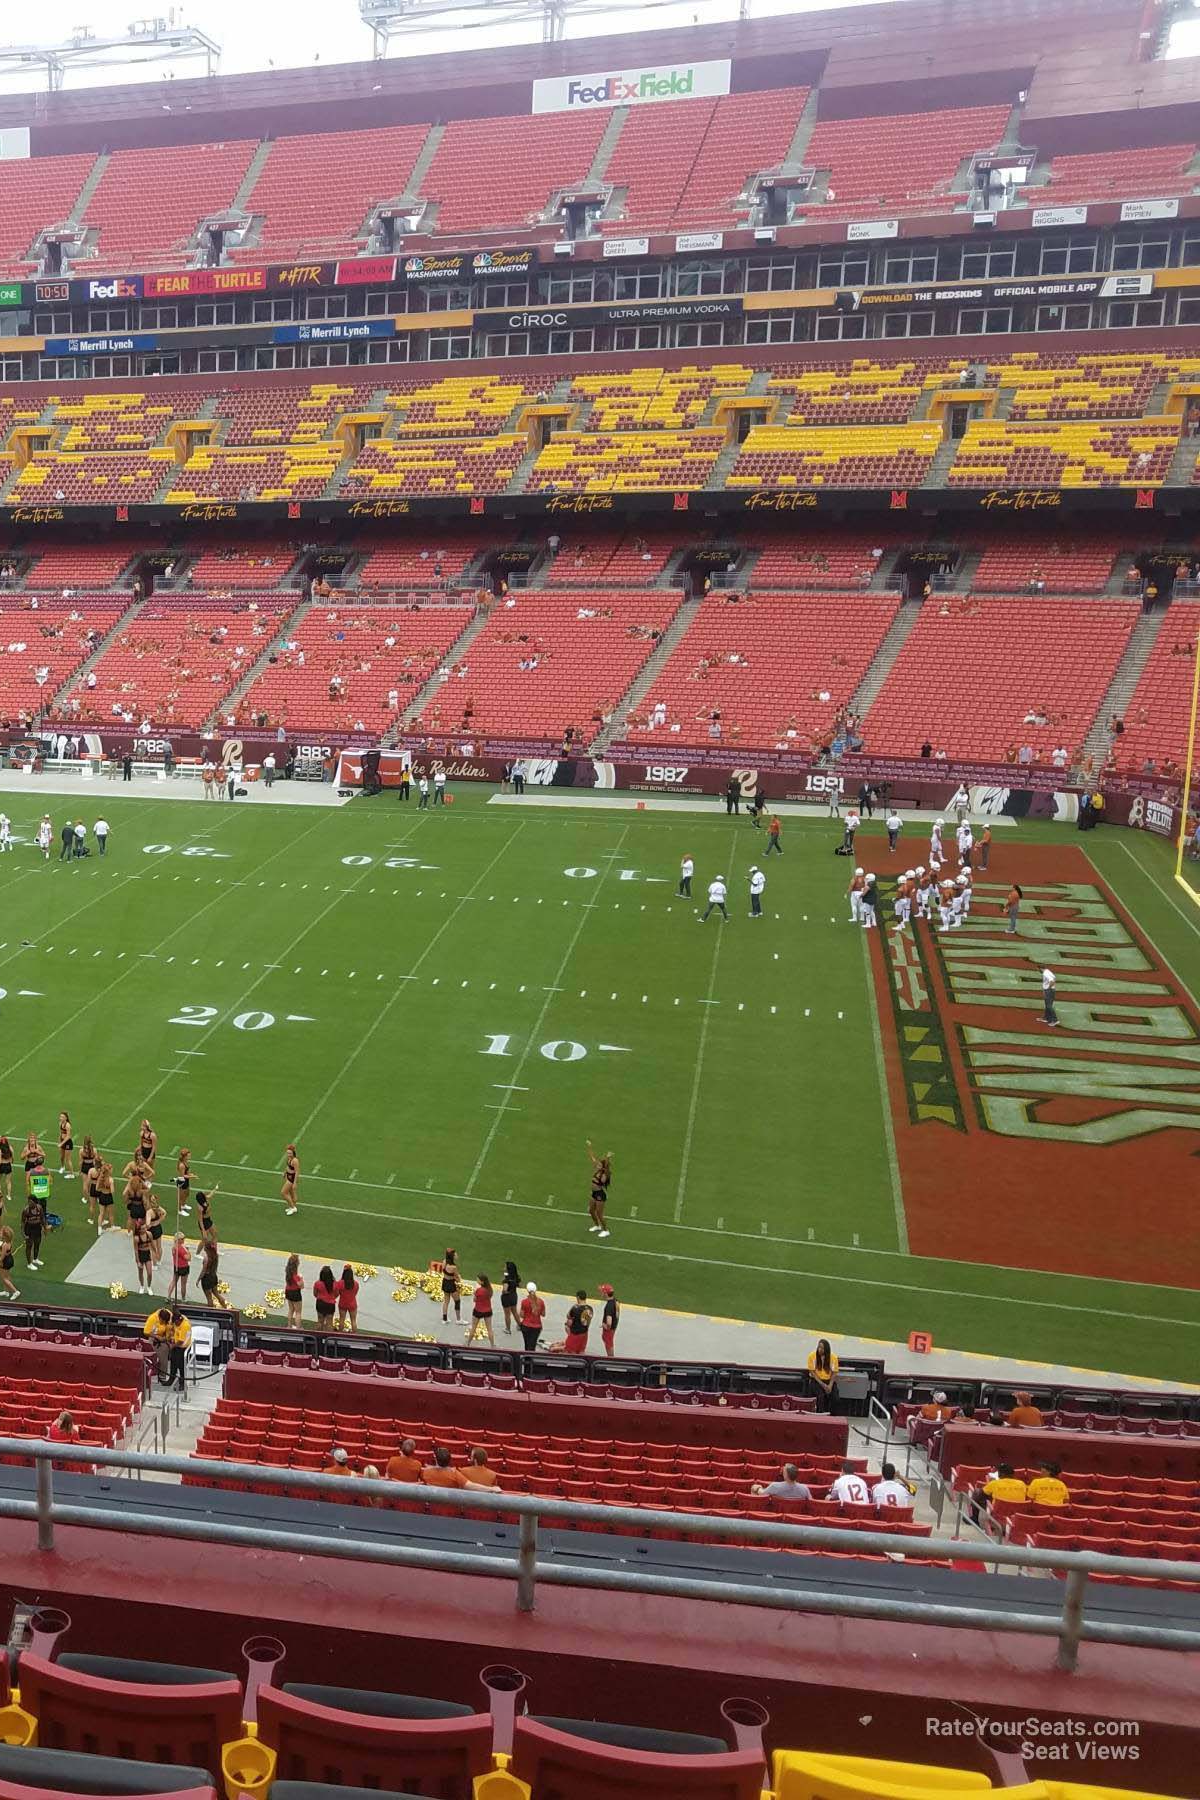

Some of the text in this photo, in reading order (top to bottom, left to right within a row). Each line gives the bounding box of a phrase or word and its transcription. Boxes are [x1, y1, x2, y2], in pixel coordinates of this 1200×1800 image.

[568, 70, 693, 104] FedExField
[422, 256, 464, 271] Sports
[491, 251, 533, 266] Sports
[406, 269, 460, 279] WASHINGTON
[474, 264, 528, 274] WASHINGTON
[89, 279, 137, 299] FedEx
[862, 293, 913, 304] DOWNLOAD
[935, 289, 983, 299] REDSKINS
[994, 286, 1037, 297] OFFICIAL
[1038, 284, 1075, 294] MOBILE
[1076, 283, 1097, 291] APP
[609, 304, 730, 319] ULTRA PREMIUM VODKA
[311, 325, 370, 338] Merrill Lynch
[80, 339, 134, 351] Merrill Lynch
[645, 766, 689, 784] 1987
[629, 784, 650, 793] SUPER
[650, 785, 668, 793] BOWL
[168, 1006, 276, 1031] 20
[478, 1034, 588, 1062] 10
[914, 1333, 928, 1352] G
[847, 1483, 864, 1502] 12
[886, 1492, 898, 1506] 8
